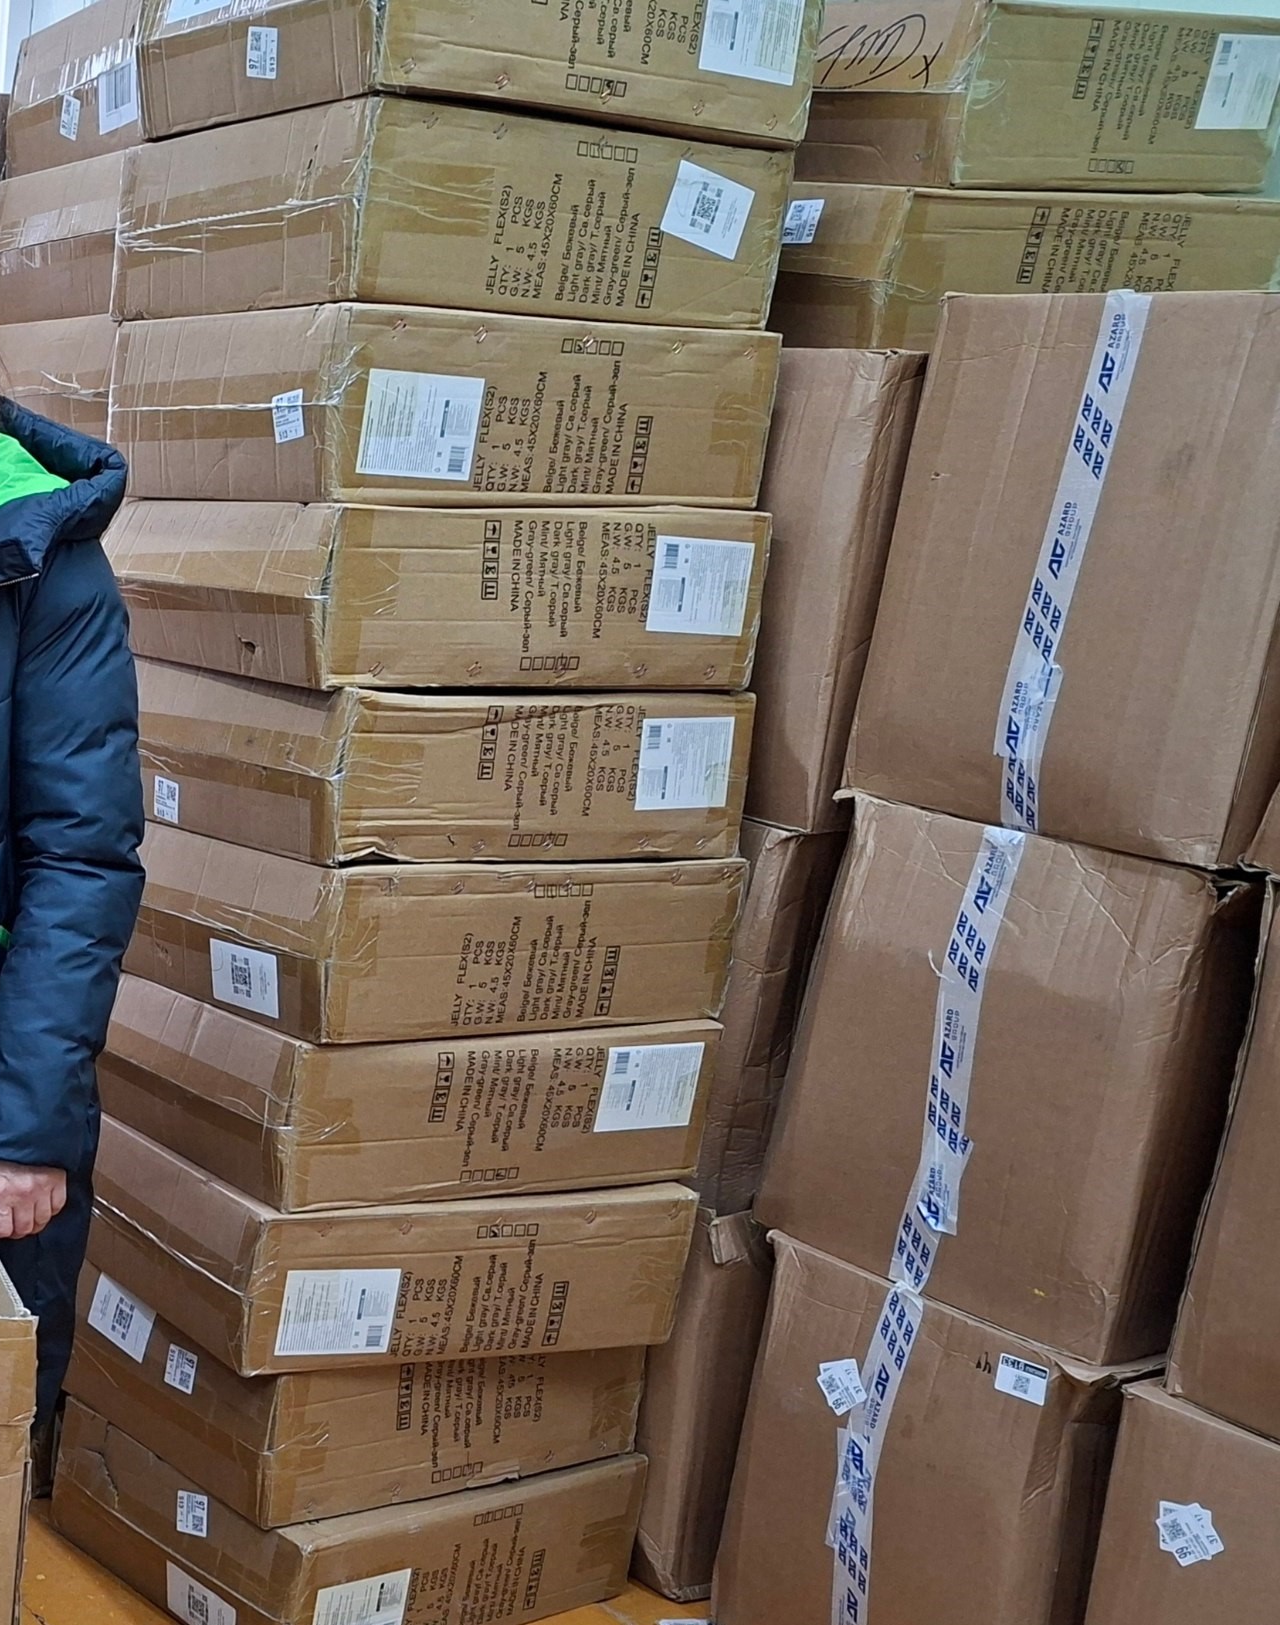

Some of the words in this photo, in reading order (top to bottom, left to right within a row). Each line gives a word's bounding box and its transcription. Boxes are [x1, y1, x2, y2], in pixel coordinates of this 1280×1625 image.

[248, 58, 259, 70] 97
[510, 195, 523, 224] PCS
[522, 198, 534, 227] KGS
[484, 255, 500, 294] JELLY
[493, 184, 513, 244] FLEX(S2)
[526, 242, 537, 261] 4.5
[533, 200, 545, 229] KGS
[625, 212, 640, 252] CHINA
[573, 240, 586, 270] gray/
[622, 255, 632, 267] IN
[554, 263, 570, 301] Beige/
[579, 275, 591, 303] Dark
[585, 242, 598, 272] gray/
[602, 236, 623, 305] Gray-green/
[567, 273, 581, 302] Light
[591, 275, 603, 304] Mint/
[615, 269, 629, 306] MADE
[1107, 313, 1121, 349] AZARD
[495, 395, 507, 422] PCS
[507, 397, 519, 424] KGS
[613, 403, 627, 442] CHINA
[472, 454, 486, 491] JELLY
[479, 385, 497, 442] FLEX(S2)
[513, 438, 523, 456] 4.5
[519, 398, 530, 425] KGS
[561, 434, 573, 462] gray/
[572, 435, 586, 463] gray/
[591, 426, 611, 493] Gray-green/
[611, 444, 620, 455] IN
[542, 457, 558, 492] Beige/
[556, 466, 568, 492] Light
[568, 467, 579, 492] Dark
[580, 466, 591, 493] Mint/
[605, 459, 618, 493] MADE
[1057, 501, 1072, 536] AZARD
[512, 519, 522, 556] MADE
[540, 520, 549, 548] Mint/
[552, 520, 562, 547] Dark
[563, 521, 574, 548] Light
[575, 521, 587, 556] Beige/
[645, 523, 656, 557] JELLY
[511, 558, 520, 570] IN
[523, 520, 537, 587] Gray-green/
[549, 550, 560, 578] gray/
[561, 551, 572, 579] gray/
[610, 556, 620, 574] 4.5
[509, 573, 519, 611] CHINA
[606, 586, 615, 612] KGS
[616, 587, 626, 613] KGS
[627, 589, 637, 614] PCS
[637, 568, 652, 622] FLEX(S2)
[1010, 681, 1024, 714] AZARD
[616, 769, 626, 792] PCS
[943, 1008, 954, 1039] AZARD
[870, 1402, 882, 1429] AZARD
[1175, 1545, 1192, 1560] 99
